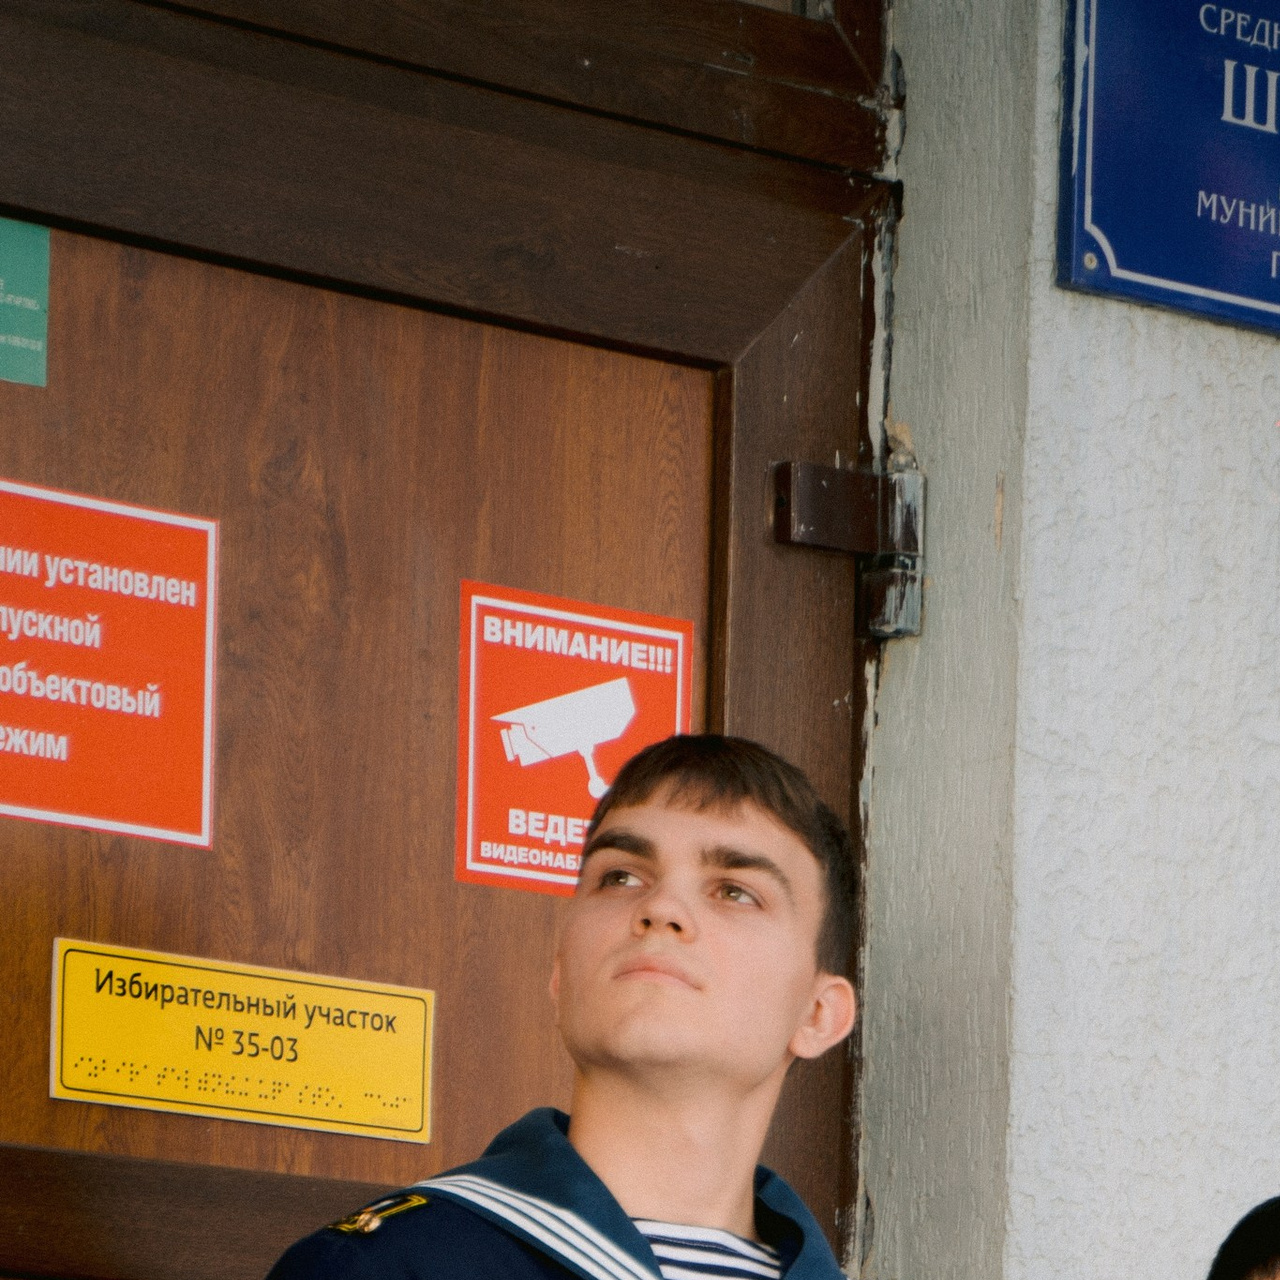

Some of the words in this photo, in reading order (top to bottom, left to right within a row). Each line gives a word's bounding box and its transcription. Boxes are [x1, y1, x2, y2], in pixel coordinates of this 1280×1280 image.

[45, 554, 197, 608] установлен
[483, 615, 673, 674] ВНИМАНИЕ!!!
[0, 661, 161, 718] объектовый
[508, 808, 592, 847] ВЕДЕ
[480, 841, 583, 871] ВИДЕОНАБ
[94, 968, 297, 1021] Избирательный
[304, 1002, 398, 1034] участок
[231, 1030, 299, 1063] 35-03
